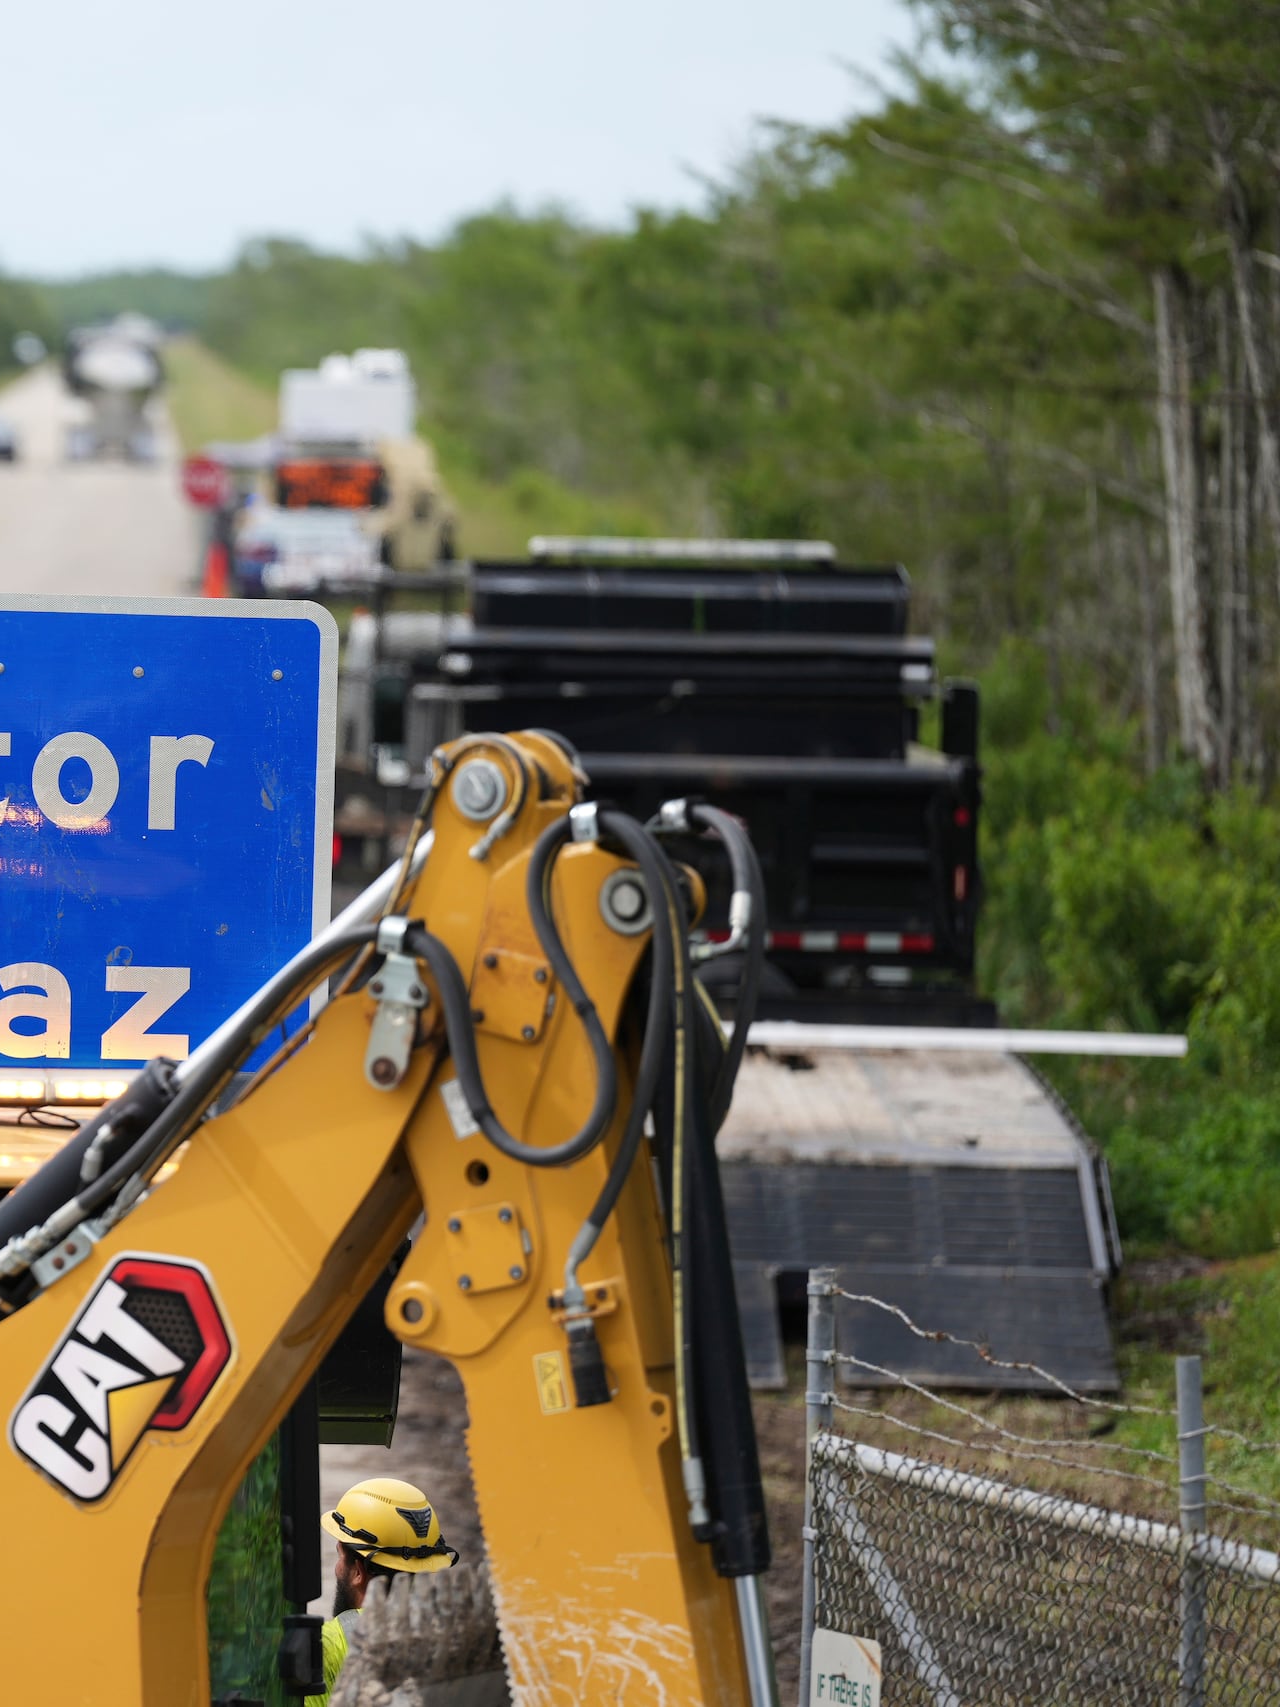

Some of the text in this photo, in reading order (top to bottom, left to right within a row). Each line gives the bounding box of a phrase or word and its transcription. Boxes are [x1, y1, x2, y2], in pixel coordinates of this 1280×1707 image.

[13, 1279, 186, 1499] CAT
[816, 1672, 872, 1707] IF THERE IS
